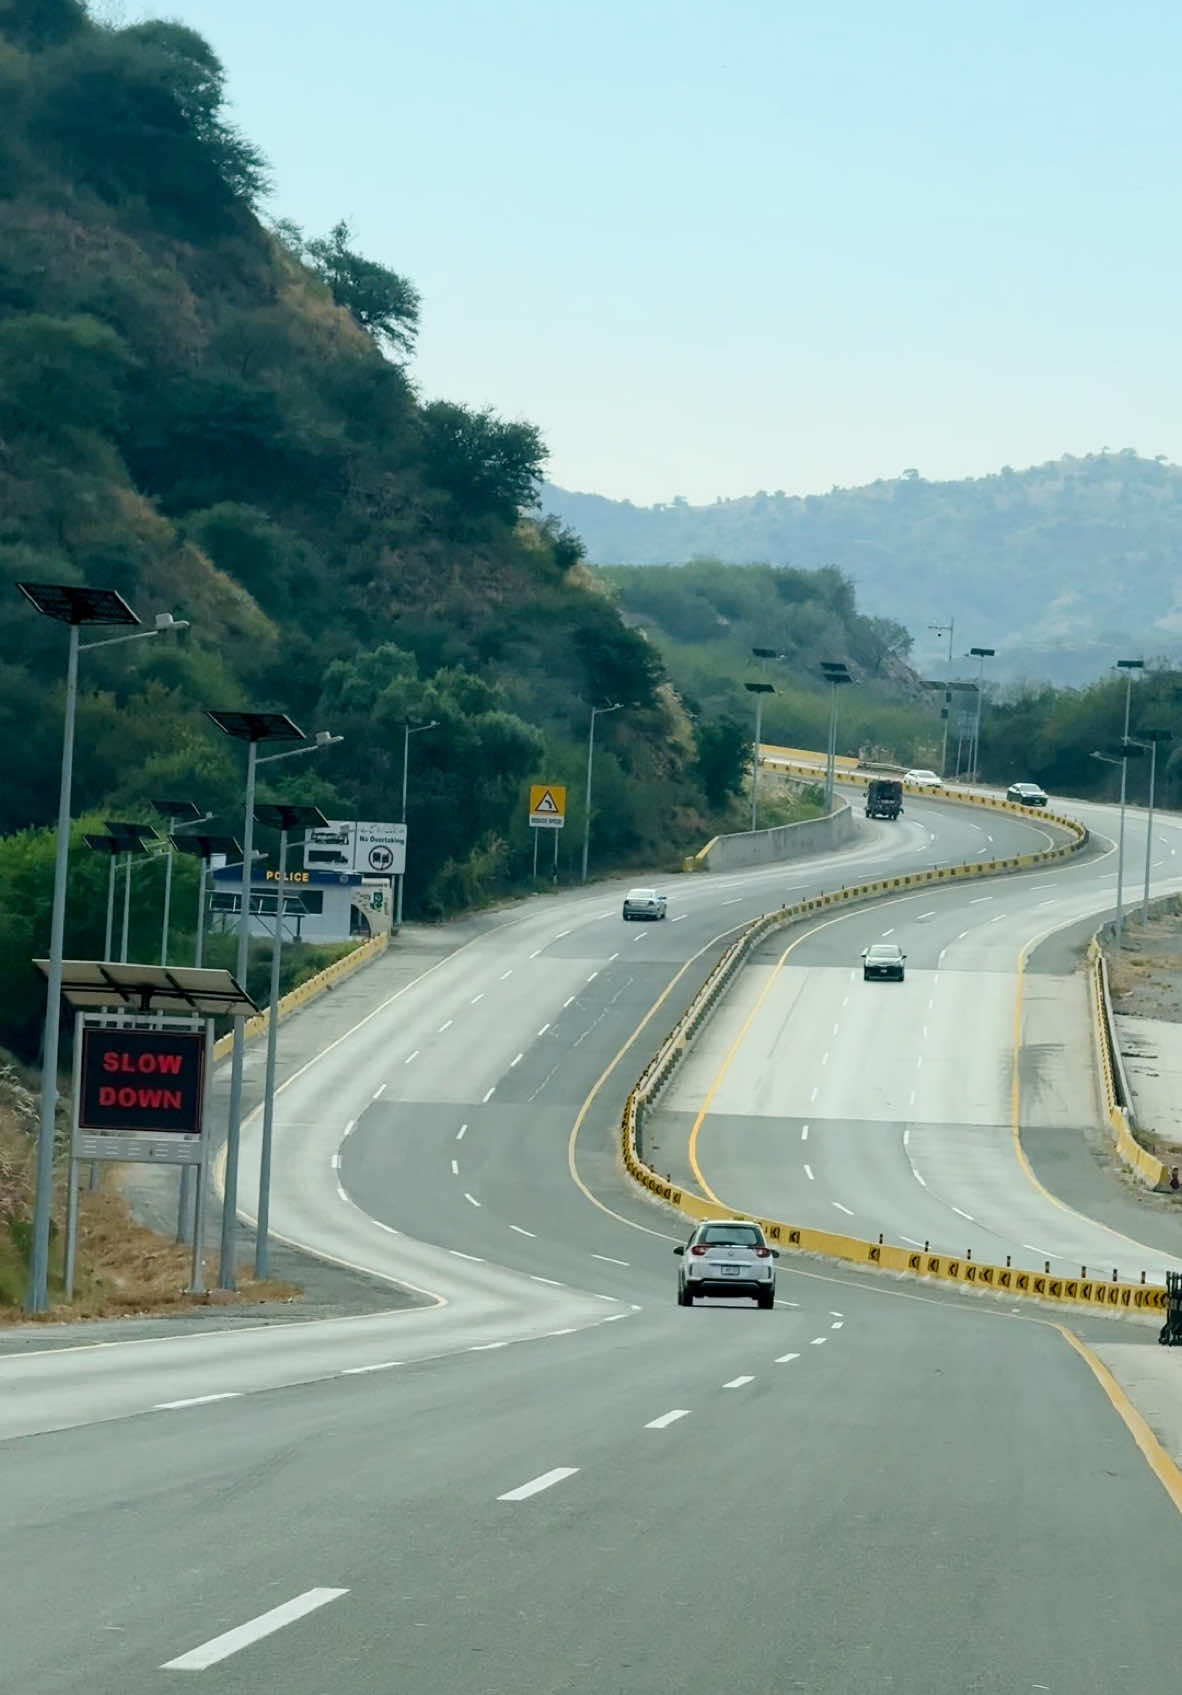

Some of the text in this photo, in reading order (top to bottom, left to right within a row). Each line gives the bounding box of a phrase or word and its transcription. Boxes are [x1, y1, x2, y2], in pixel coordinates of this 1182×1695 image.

[266, 871, 310, 882] POLICE
[103, 1051, 184, 1075] SLOW
[99, 1086, 182, 1109] DOWN
